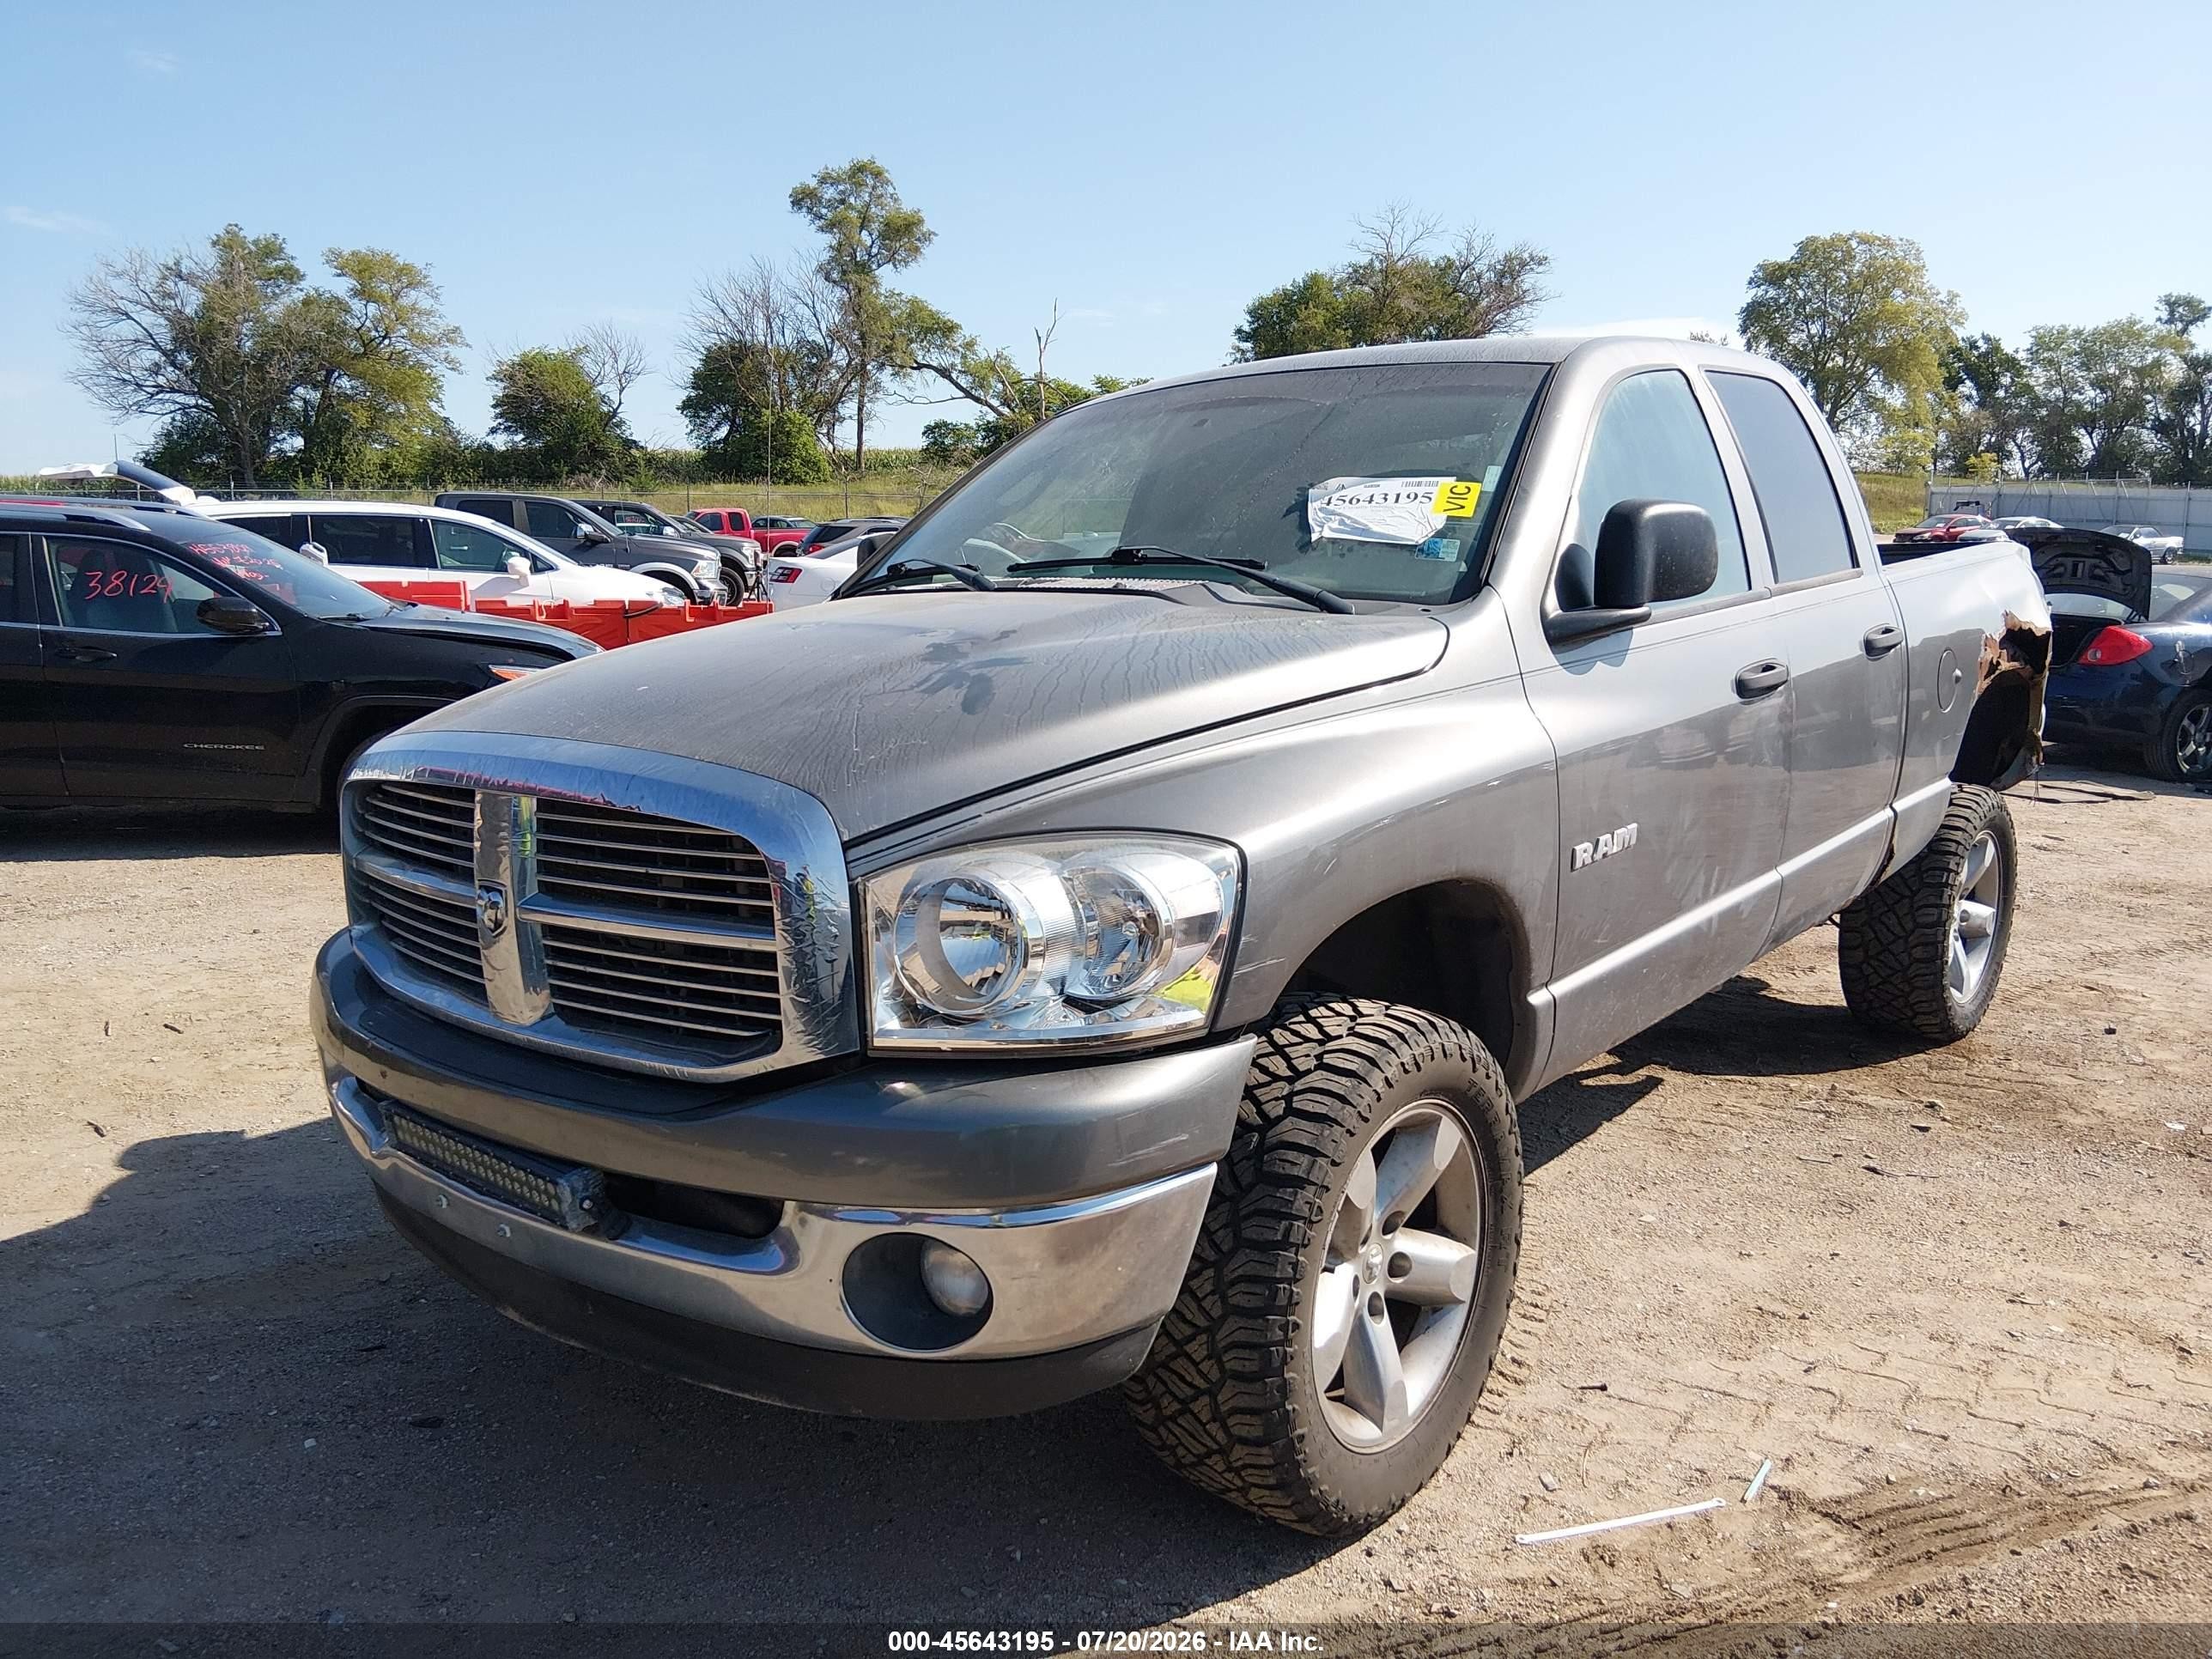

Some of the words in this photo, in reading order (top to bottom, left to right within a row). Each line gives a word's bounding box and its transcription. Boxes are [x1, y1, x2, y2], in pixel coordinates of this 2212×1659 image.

[1321, 491, 1434, 507] 45643195
[1443, 484, 1471, 513] VIC
[1570, 822, 1638, 872] RAM
